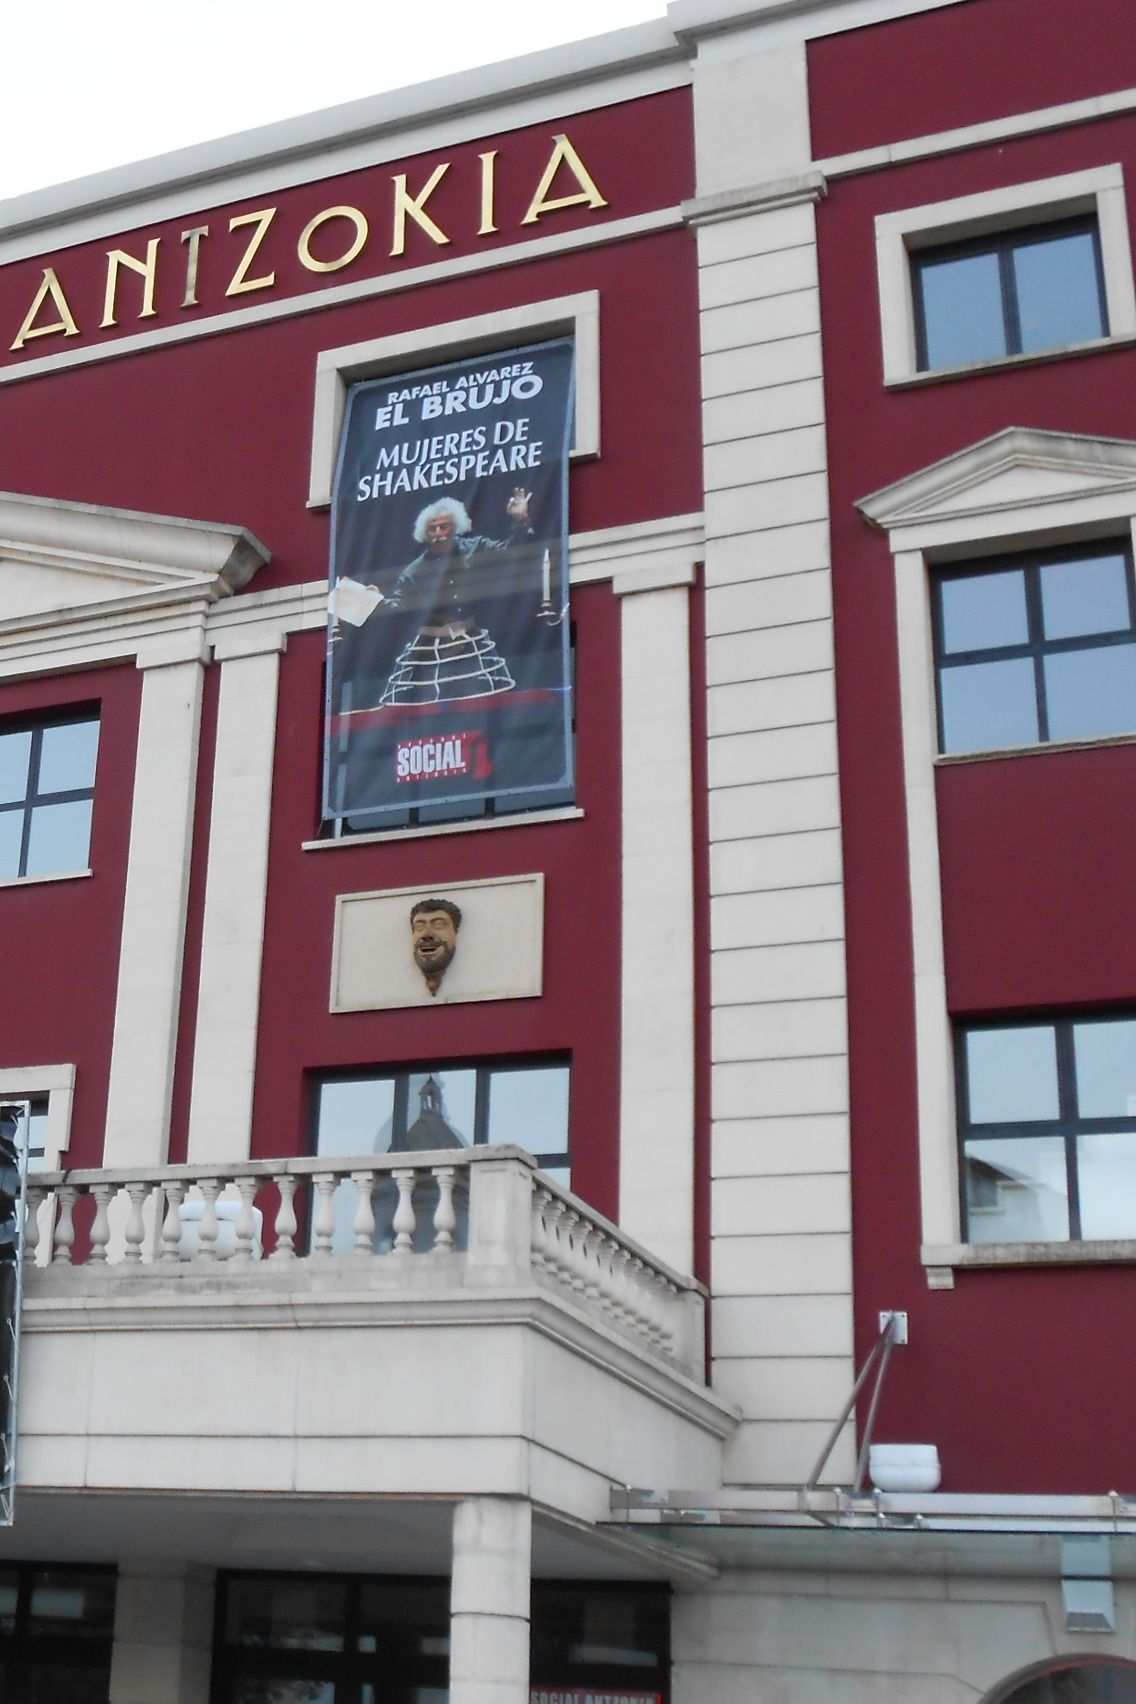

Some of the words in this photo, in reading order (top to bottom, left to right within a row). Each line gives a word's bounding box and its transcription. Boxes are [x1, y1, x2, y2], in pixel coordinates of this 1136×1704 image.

[9, 134, 608, 350] ANTZOKIA
[375, 403, 409, 431] EL
[421, 374, 544, 420] BRUJO
[388, 381, 450, 404] RAFAEL
[455, 361, 534, 389] ALVAREZ
[376, 426, 486, 470] MUJERES
[493, 418, 530, 445] DE
[357, 441, 543, 502] SHAKESPEARE
[397, 739, 466, 776] SOCIAL
